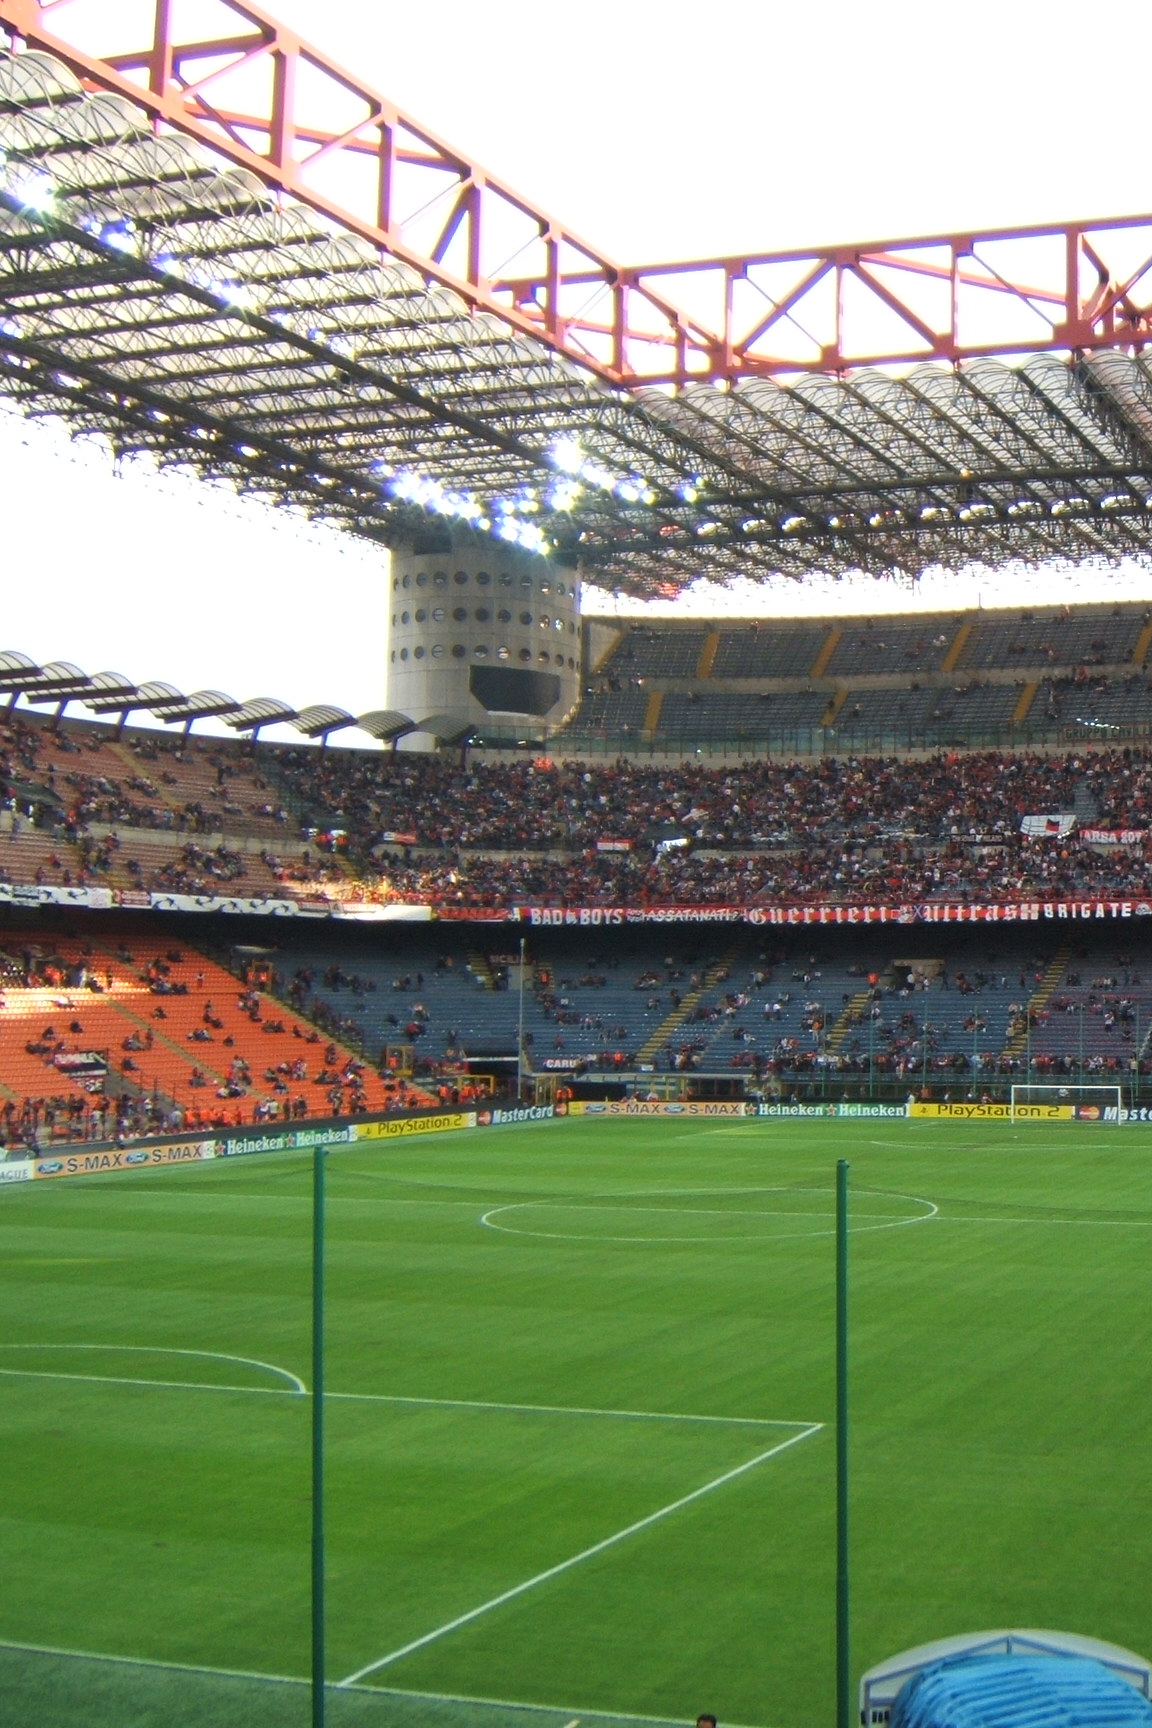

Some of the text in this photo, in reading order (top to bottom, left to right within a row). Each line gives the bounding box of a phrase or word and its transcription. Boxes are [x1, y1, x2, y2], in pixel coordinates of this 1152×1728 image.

[531, 909, 563, 925] BAD
[580, 908, 623, 925] BOYS
[1044, 903, 1132, 919] BRIGATE
[491, 1104, 553, 1125] MasterCard
[610, 1103, 660, 1114] S-MAX
[689, 1104, 739, 1115] S-MAX
[758, 1103, 904, 1117] Heineken Heineken
[937, 1104, 1060, 1118] PlayStation 2
[377, 1113, 463, 1135] PlayStation 2
[226, 1128, 349, 1155] Heineken Heineken
[66, 1153, 122, 1173] S-MAX
[152, 1144, 202, 1163] S-MAX
